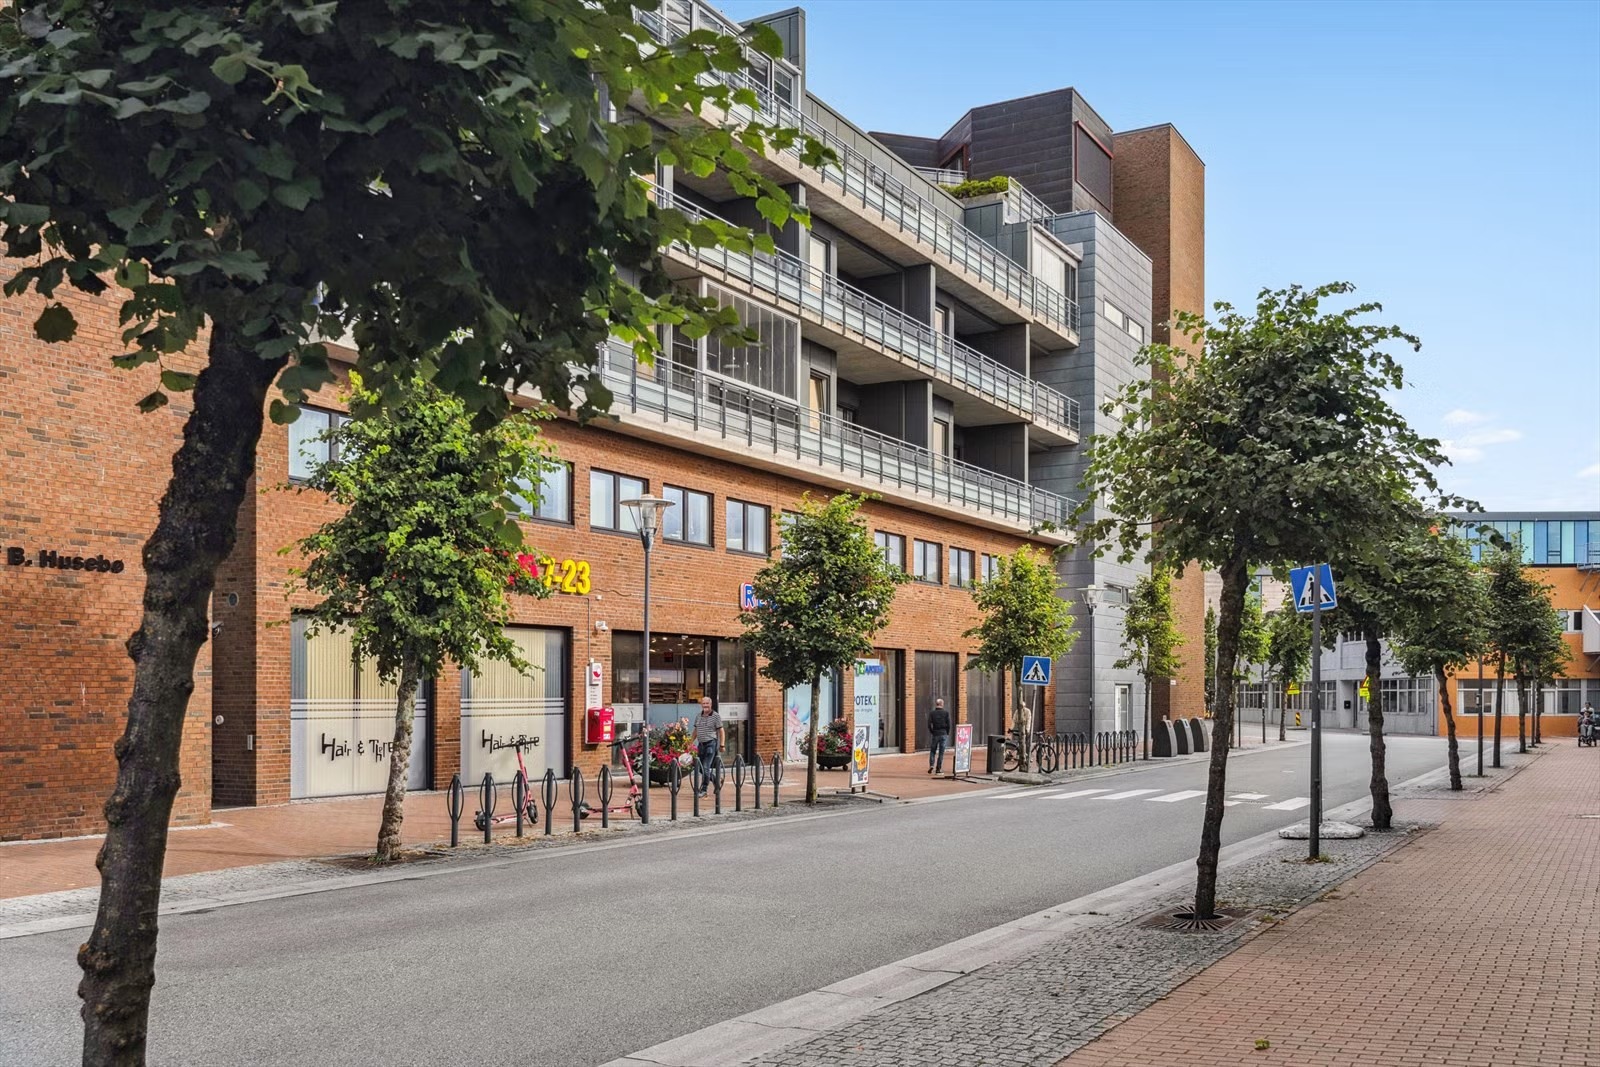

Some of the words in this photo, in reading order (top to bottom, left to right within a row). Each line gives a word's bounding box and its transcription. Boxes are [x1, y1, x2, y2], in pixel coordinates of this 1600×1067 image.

[7, 546, 33, 566] B.
[39, 549, 125, 574] Husebø
[321, 732, 352, 761] Hair
[357, 740, 365, 755] &
